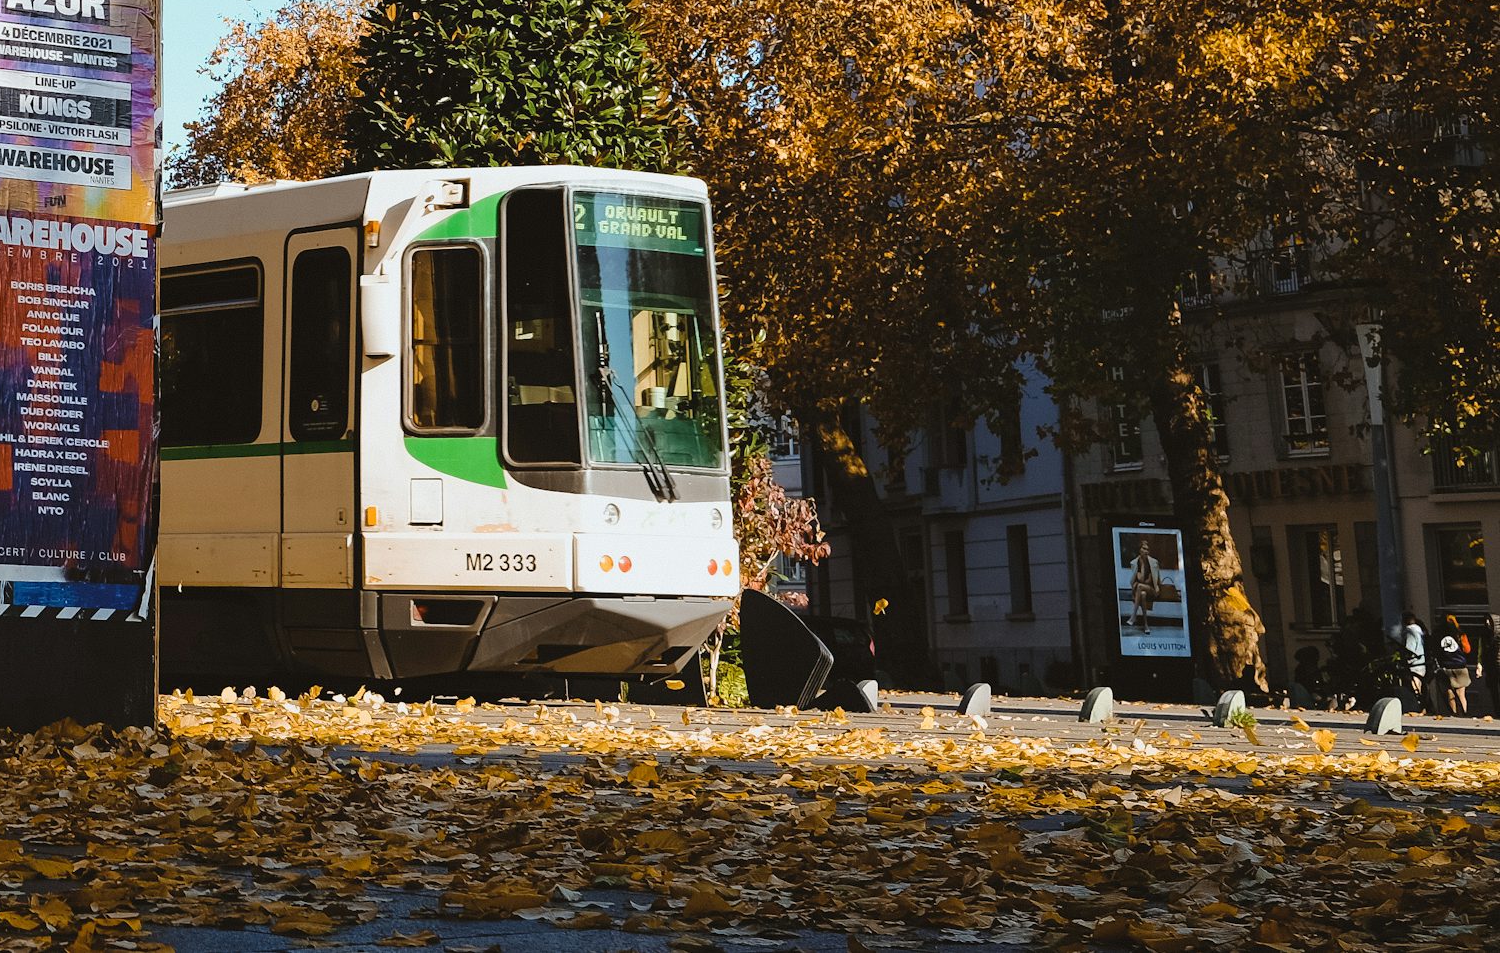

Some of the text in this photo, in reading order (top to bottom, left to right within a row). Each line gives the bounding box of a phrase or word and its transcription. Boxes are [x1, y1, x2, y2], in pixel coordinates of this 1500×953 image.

[1, 26, 113, 50] 4 DÉCEMBRE 2021
[73, 53, 117, 68] NANTES
[35, 77, 77, 90] LINE-UP
[19, 94, 92, 119] KUNGS
[48, 125, 85, 138] VICTOR
[87, 129, 118, 141] FLASH
[90, 176, 115, 185] NANTES
[574, 203, 587, 230] 2
[605, 205, 679, 224] ORVAULT
[598, 221, 688, 241] GRAND VAL
[97, 255, 148, 270] 2021
[10, 280, 96, 296] BORIS BREJCHA
[17, 295, 89, 310] BOB SINCLAR
[27, 310, 80, 322] ANN CLUE
[22, 323, 84, 336] FOLAMOUR
[20, 337, 85, 350] TEO LAVABO
[38, 352, 67, 363] BILLX
[31, 365, 75, 377] VANDAL
[27, 379, 78, 391] DARKTEK
[16, 392, 88, 405] MAISSOUILLE
[20, 407, 84, 419] DUB ORDER
[1111, 366, 1131, 456] HTEL
[23, 420, 80, 433] WORAKLS
[18, 434, 27, 443] &
[27, 435, 63, 445] DEREK
[15, 448, 87, 461] HADRA X EDC
[14, 461, 89, 475] IRÈNE DRESEL
[30, 477, 72, 488] SCYLLA
[32, 492, 70, 502] BLANC
[37, 506, 64, 516] N'TO
[38, 548, 86, 560] CULTURE
[98, 551, 126, 562] CLUB
[466, 553, 537, 572] M2 333
[1158, 643, 1187, 651] VUITTON
